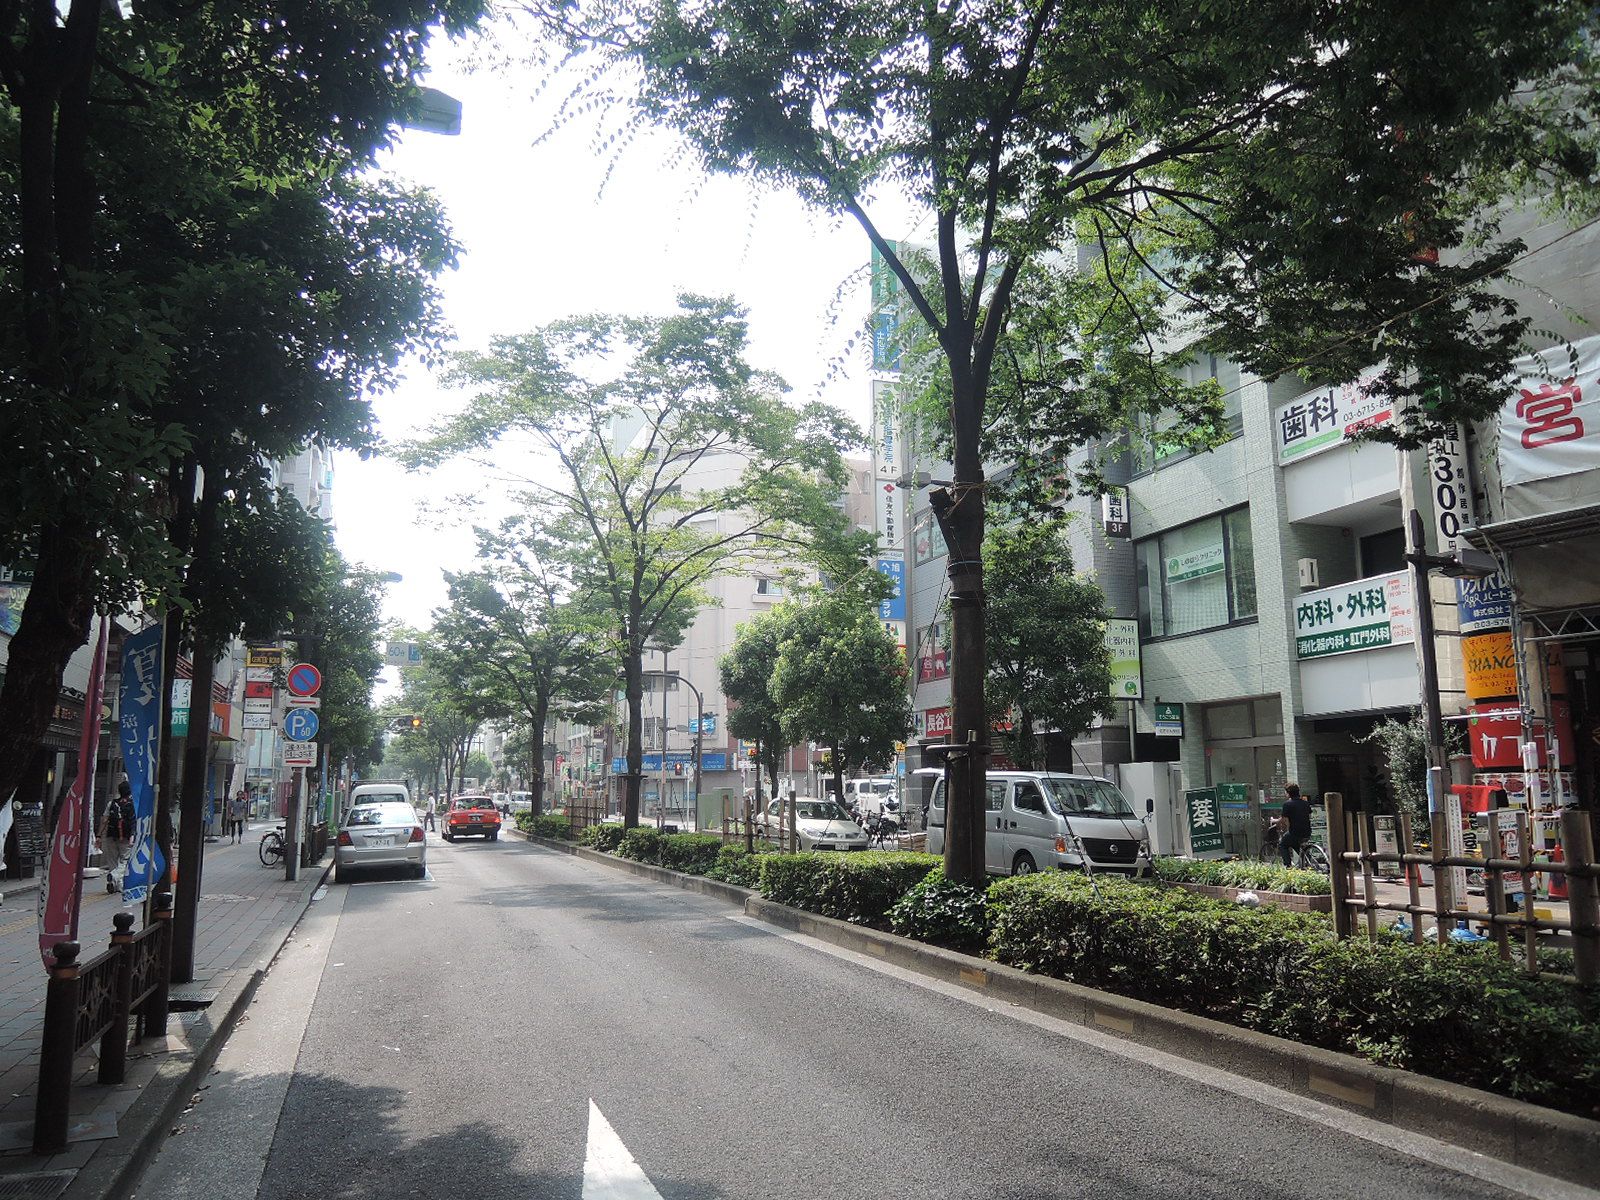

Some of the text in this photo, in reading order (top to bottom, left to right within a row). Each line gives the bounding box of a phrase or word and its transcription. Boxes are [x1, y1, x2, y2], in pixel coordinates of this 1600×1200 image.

[1280, 390, 1339, 446] 歯科
[1516, 376, 1600, 449] 営
[1112, 523, 1123, 533] 3F
[1297, 586, 1387, 629] 内科・外科
[1298, 626, 1390, 654] 消化器内科・肛門外科
[292, 716, 306, 736] P
[1191, 798, 1215, 828] 薬
